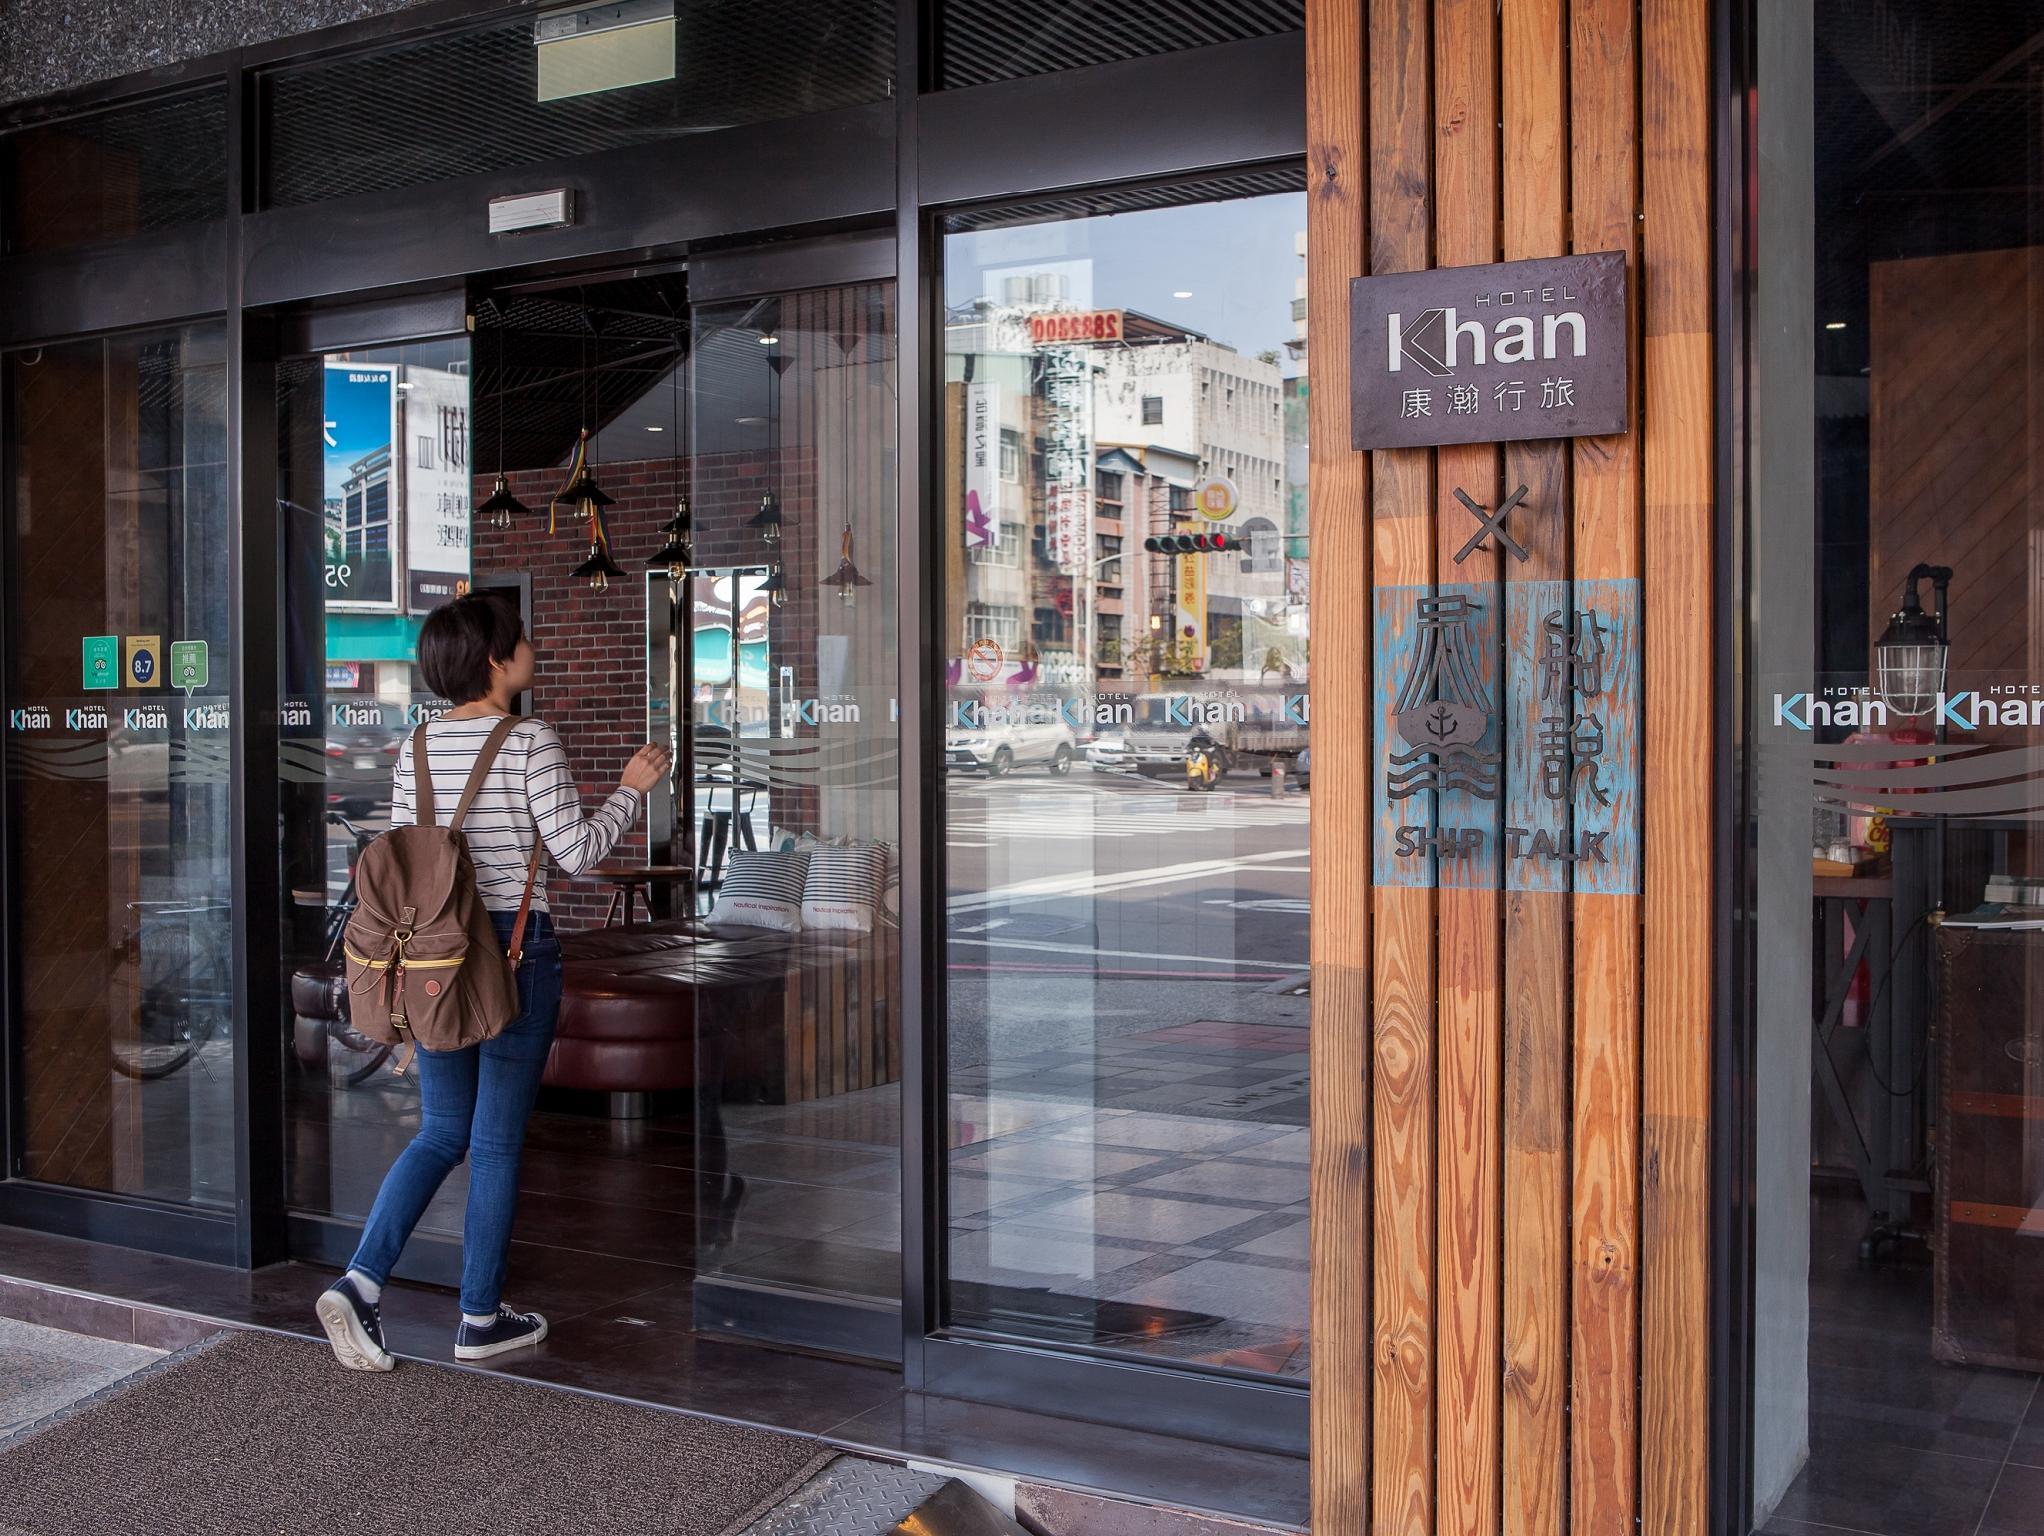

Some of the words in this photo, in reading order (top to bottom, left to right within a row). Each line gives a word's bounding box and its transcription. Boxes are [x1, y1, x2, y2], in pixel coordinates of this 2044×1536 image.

[1475, 286, 1576, 308] HOTEL
[1387, 307, 1587, 377] Khan
[1400, 376, 1575, 419] 康瀚行旅
[134, 660, 152, 674] 8.7
[1824, 687, 1881, 696] HOTEL
[11, 708, 51, 731] Khan
[66, 708, 108, 731] Khan
[123, 708, 168, 731] Khan
[183, 707, 230, 731] Khan
[279, 709, 311, 726] han
[331, 704, 382, 728] Khan
[403, 703, 453, 728] Kha
[794, 699, 861, 726] Khan
[1055, 698, 1133, 728] Khan
[1165, 695, 1245, 727] Khan
[1773, 693, 1887, 731] Khan
[1394, 825, 1485, 859] SHIP
[1504, 827, 1610, 863] TALK
